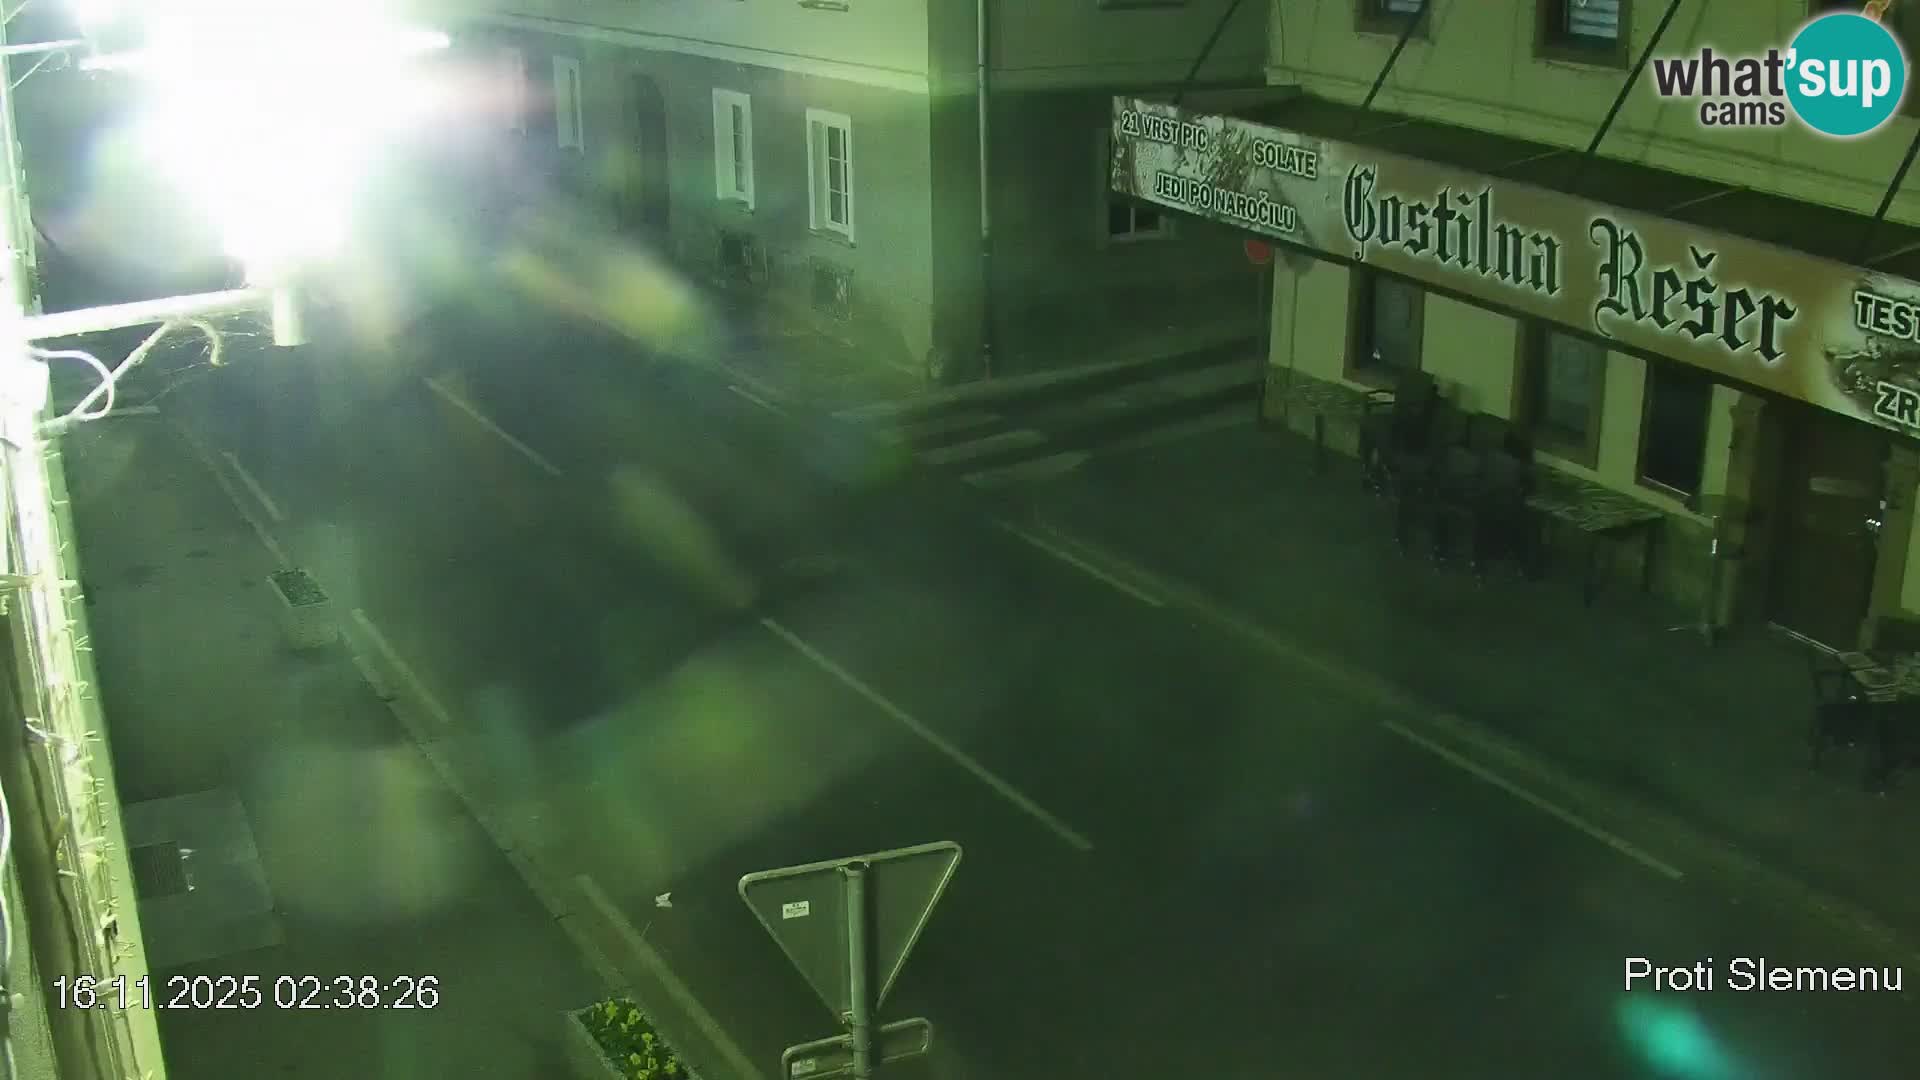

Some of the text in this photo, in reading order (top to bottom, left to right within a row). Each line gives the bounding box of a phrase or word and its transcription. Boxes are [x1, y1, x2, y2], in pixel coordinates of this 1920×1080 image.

[1122, 110, 1208, 151] 21 VRST PIC
[1253, 139, 1317, 178] SOLATE
[1156, 172, 1295, 232] JEDI PO NAROČILU
[1344, 162, 1797, 362] Gostilna Rešer
